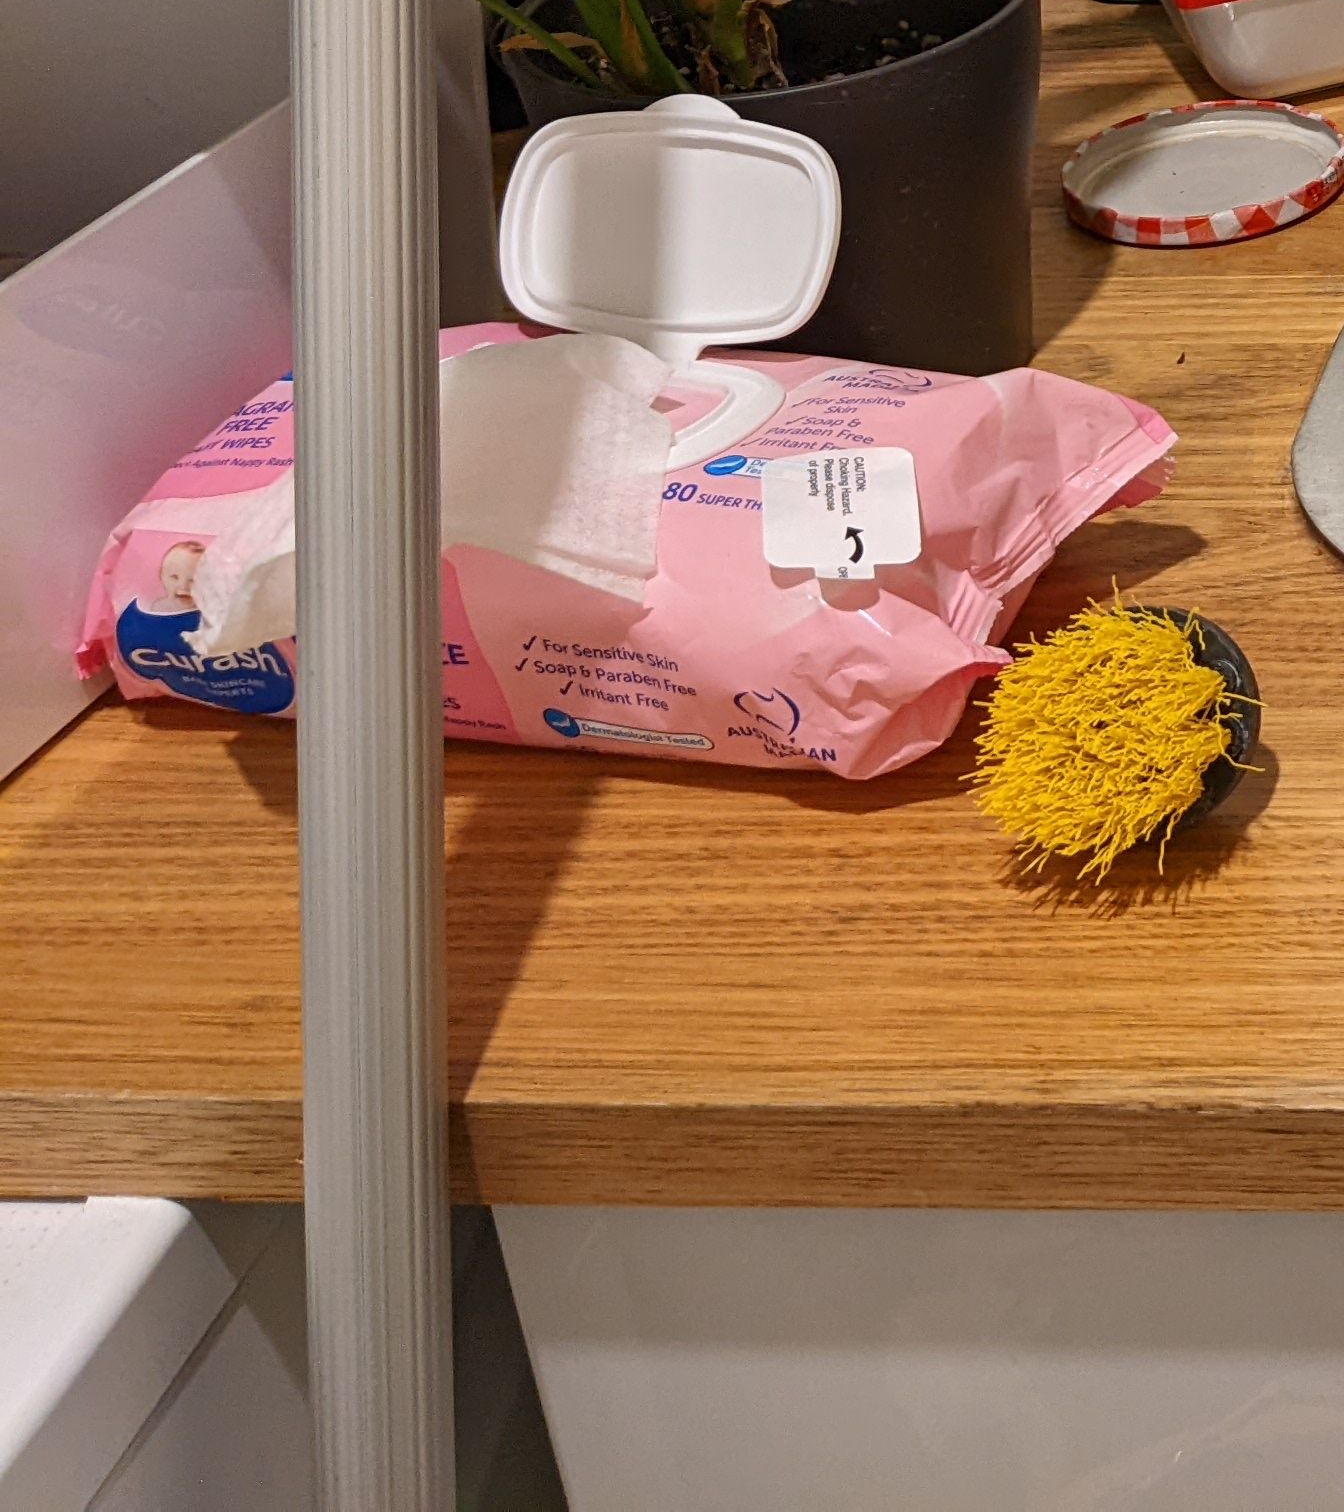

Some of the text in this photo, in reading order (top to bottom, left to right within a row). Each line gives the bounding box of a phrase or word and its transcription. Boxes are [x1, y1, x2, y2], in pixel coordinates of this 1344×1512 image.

[806, 396, 906, 408] For Sensitive
[824, 406, 858, 414] Skin
[216, 416, 280, 436] FREE
[765, 427, 874, 445] Paraben Free
[802, 418, 862, 428] Soap &
[220, 436, 276, 450] WIPES
[758, 438, 818, 450] Irritant
[192, 459, 229, 468] Against
[231, 458, 265, 468] Nappy
[838, 457, 850, 484] Choking
[854, 456, 865, 492] CAUTION:
[808, 460, 820, 496] of properly
[824, 458, 835, 512] Please dispose
[662, 482, 698, 502] 80
[696, 493, 741, 509] SUPER
[130, 647, 284, 677] Curash
[542, 639, 678, 673] For Sensitive Skin
[534, 660, 697, 696] Soap & Paraben Free
[580, 684, 669, 712] Irritant Free
[582, 722, 705, 747] Dermatologist Tested
